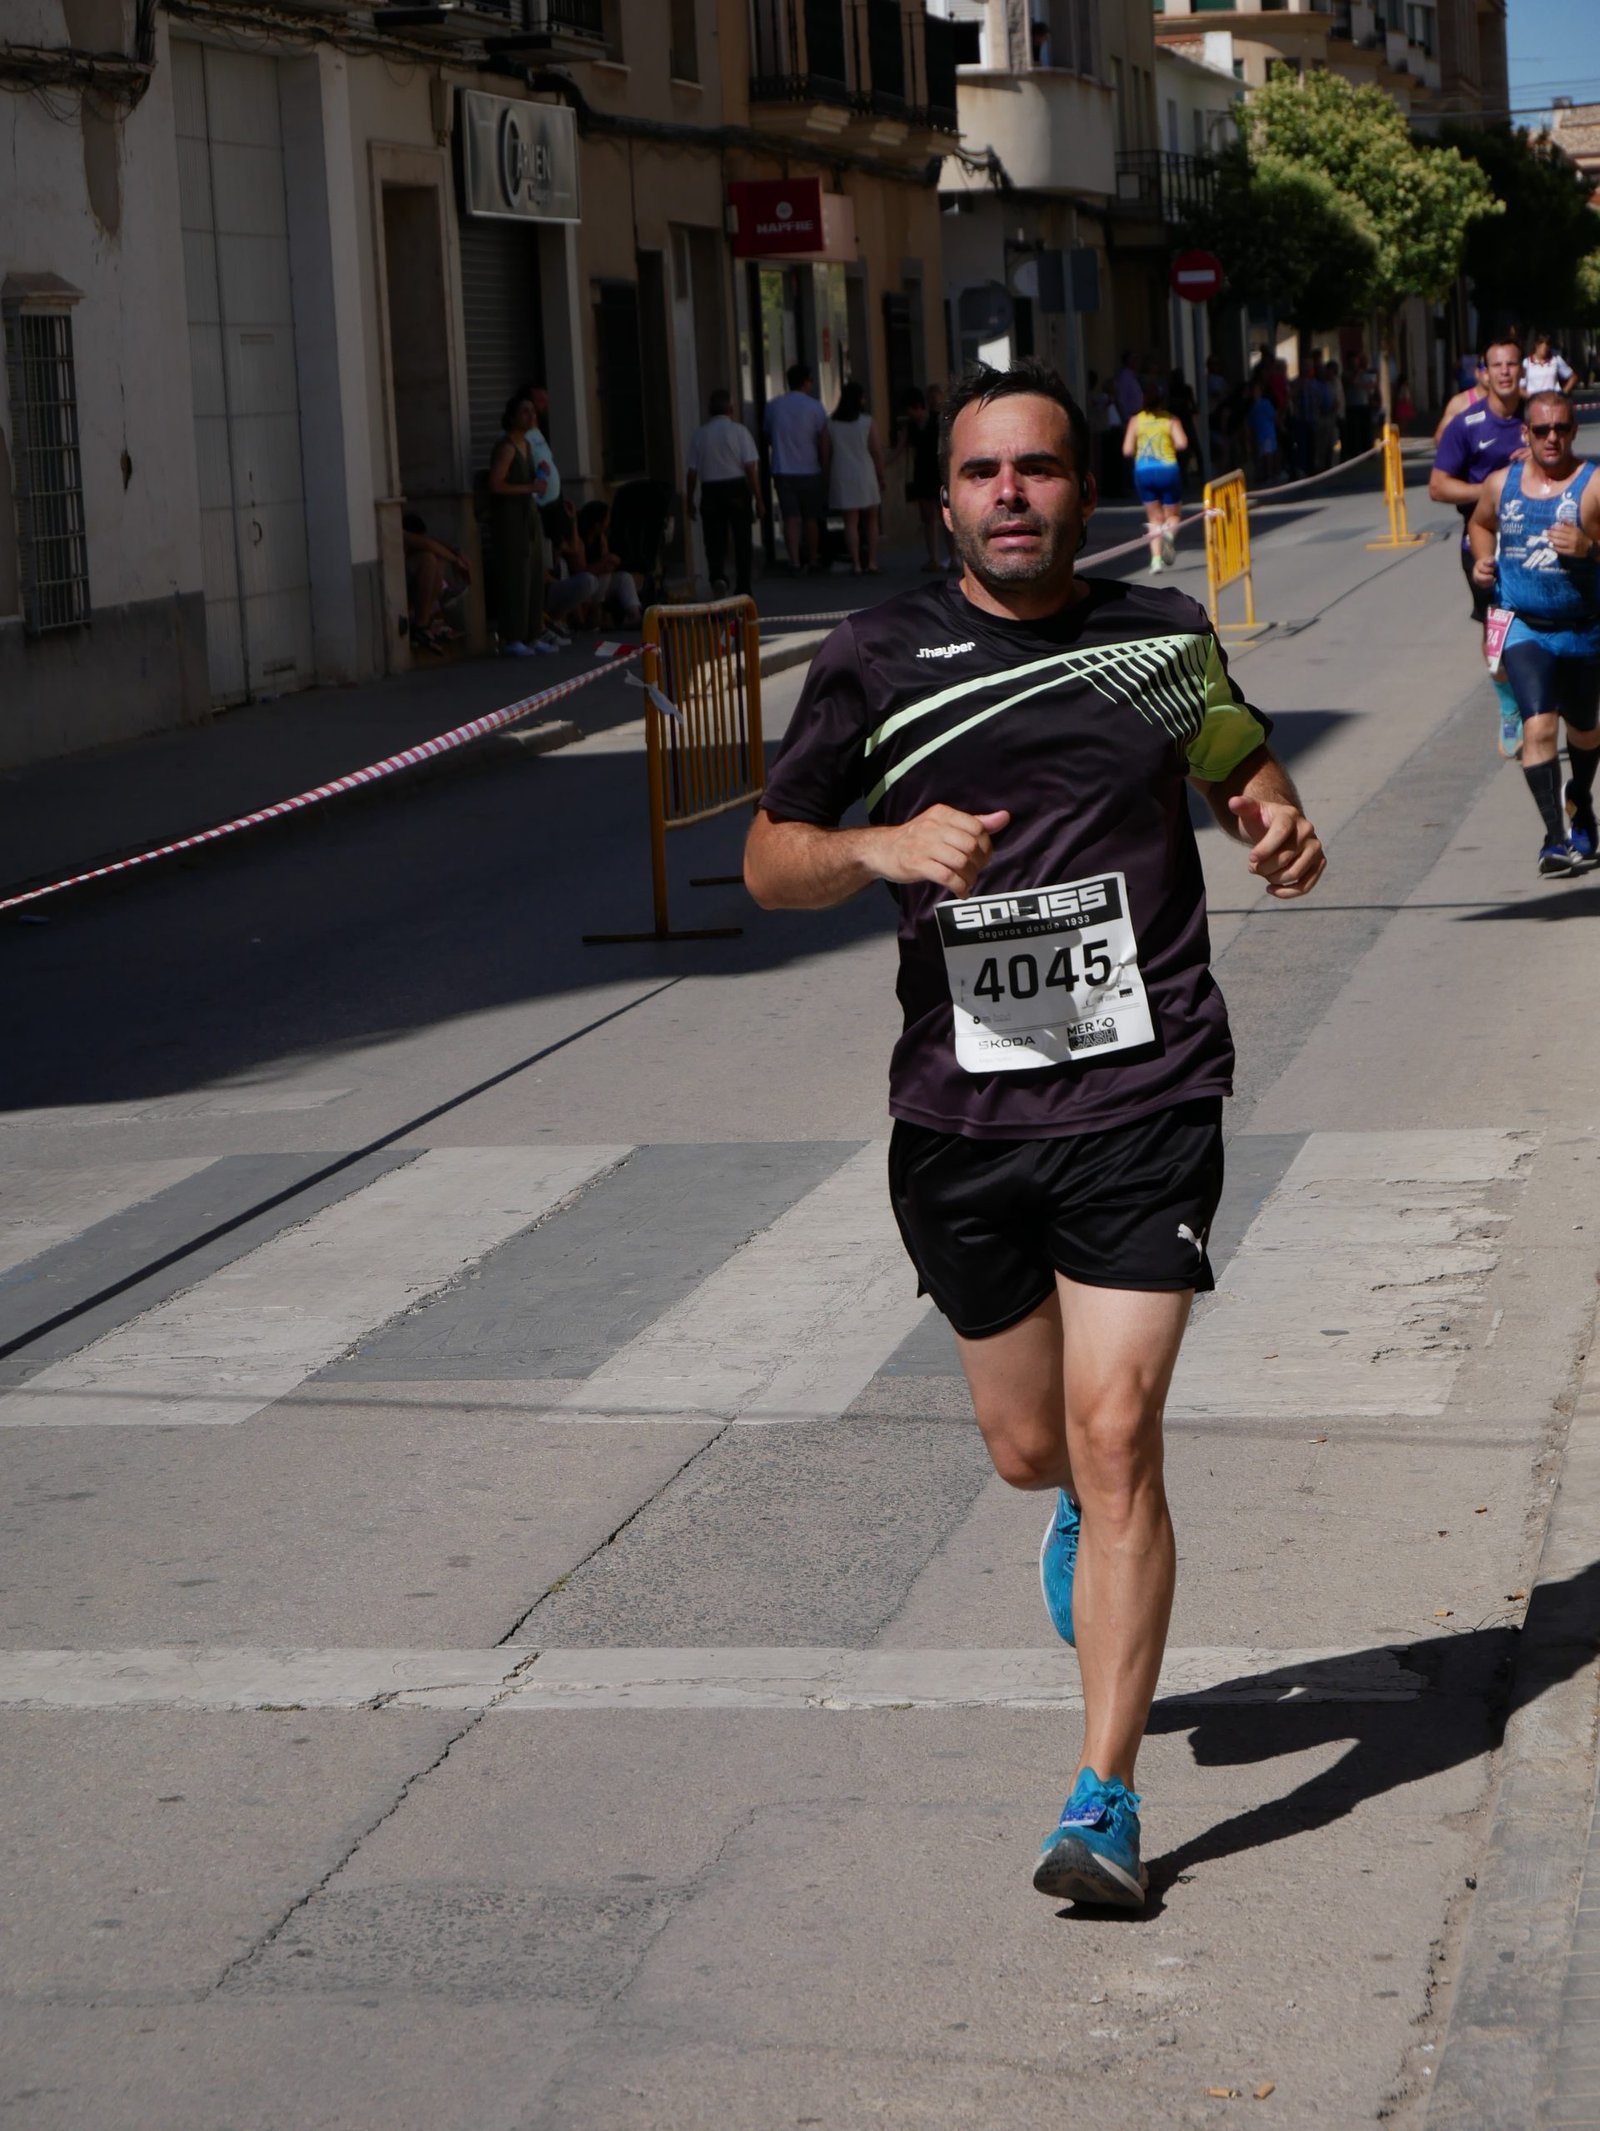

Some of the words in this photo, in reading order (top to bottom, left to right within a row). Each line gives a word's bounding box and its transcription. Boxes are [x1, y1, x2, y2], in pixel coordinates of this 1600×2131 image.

[756, 220, 814, 234] MAPFRE
[916, 641, 976, 659] Jhayber
[952, 883, 1108, 930] SOLISS
[978, 928, 1022, 939] Seguros
[1026, 921, 1060, 934] desde
[1065, 915, 1091, 927] 1933
[974, 938, 1112, 1003] 4045
[1067, 1017, 1115, 1037] MERO
[978, 1036, 1036, 1050] SKODA
[1071, 1028, 1117, 1050] CASH
